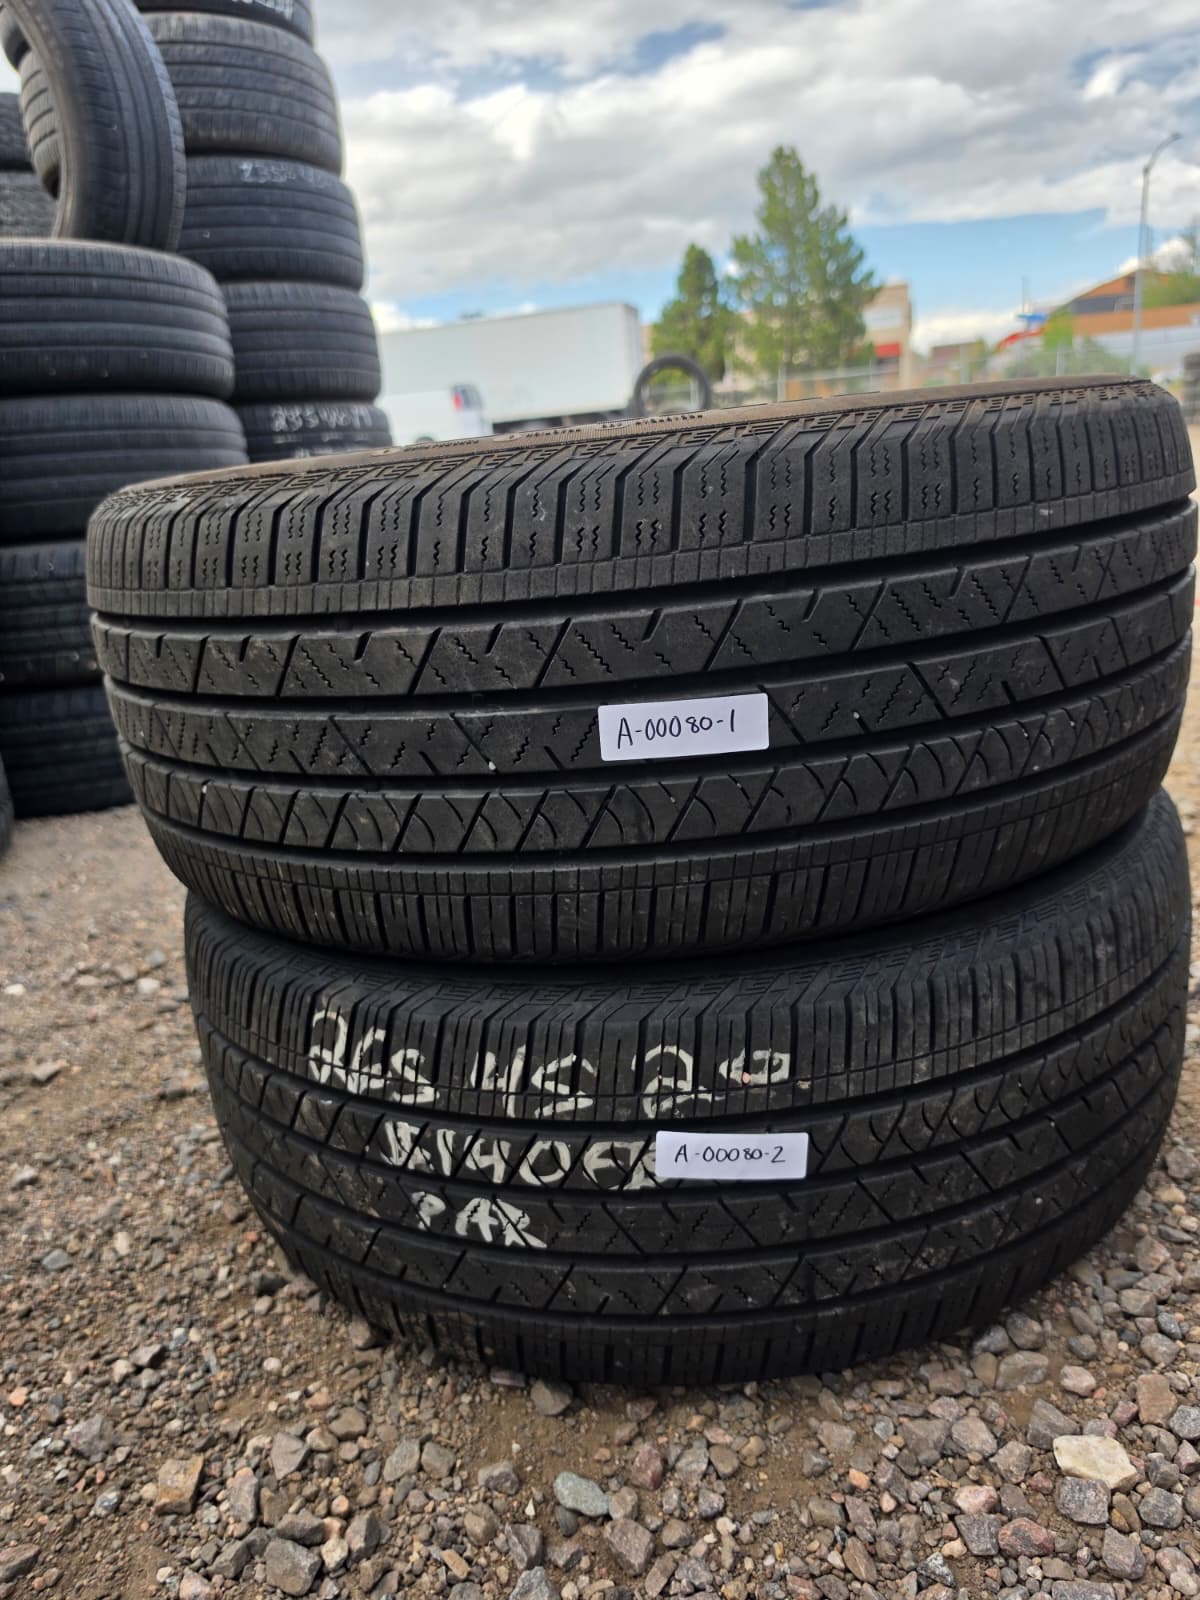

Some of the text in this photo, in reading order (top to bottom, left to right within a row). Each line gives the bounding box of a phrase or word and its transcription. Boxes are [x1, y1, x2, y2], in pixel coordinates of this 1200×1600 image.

[617, 709, 735, 749] A-00080-1
[674, 1144, 786, 1164] A-00080-2
[411, 1190, 548, 1249] PAR
